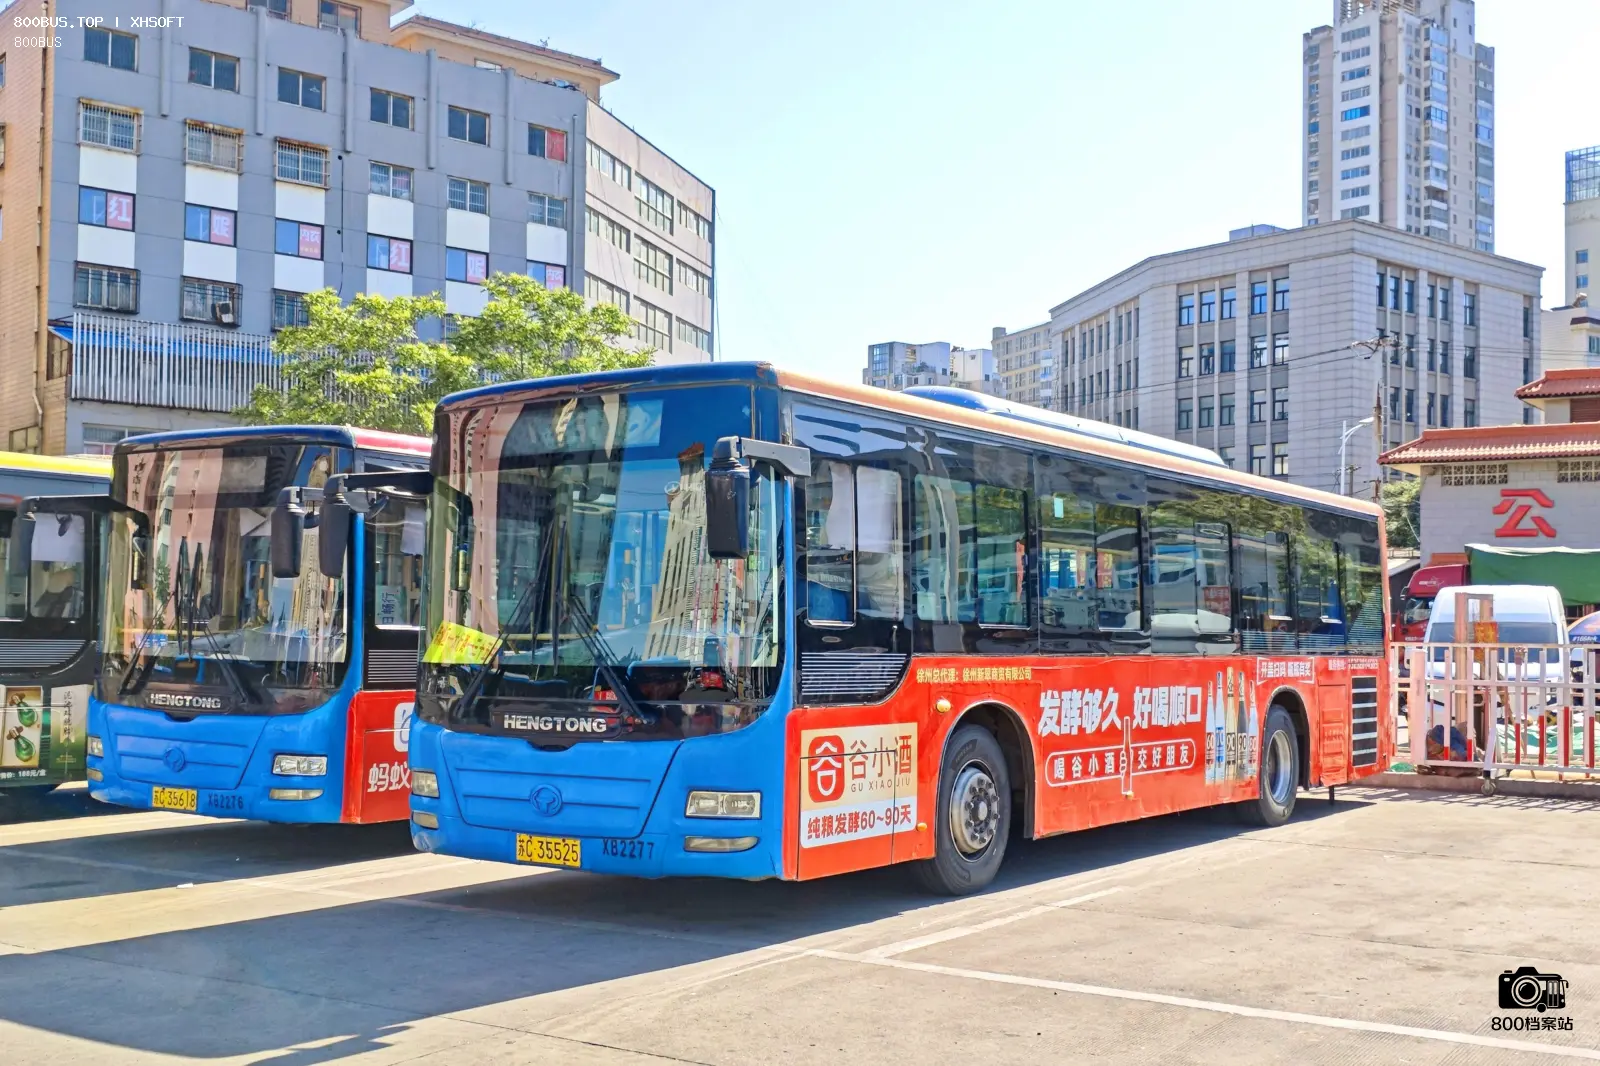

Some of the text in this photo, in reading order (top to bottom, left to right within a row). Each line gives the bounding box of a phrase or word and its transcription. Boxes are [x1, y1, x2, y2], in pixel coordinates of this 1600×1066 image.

[108, 195, 132, 223] 红
[389, 242, 409, 268] 红
[1492, 487, 1557, 538] 公
[150, 693, 222, 709] HENGTONG
[1037, 685, 1203, 738] 发酵够久 好喝顺口
[503, 714, 608, 733] HENGTONG
[848, 734, 913, 781] 谷小酒
[1053, 743, 1189, 780] 喝谷小酒 交好朋友
[367, 760, 412, 793] 蚂蚁
[850, 776, 911, 793] GU XIAO JIU
[602, 838, 656, 861] XB2277
